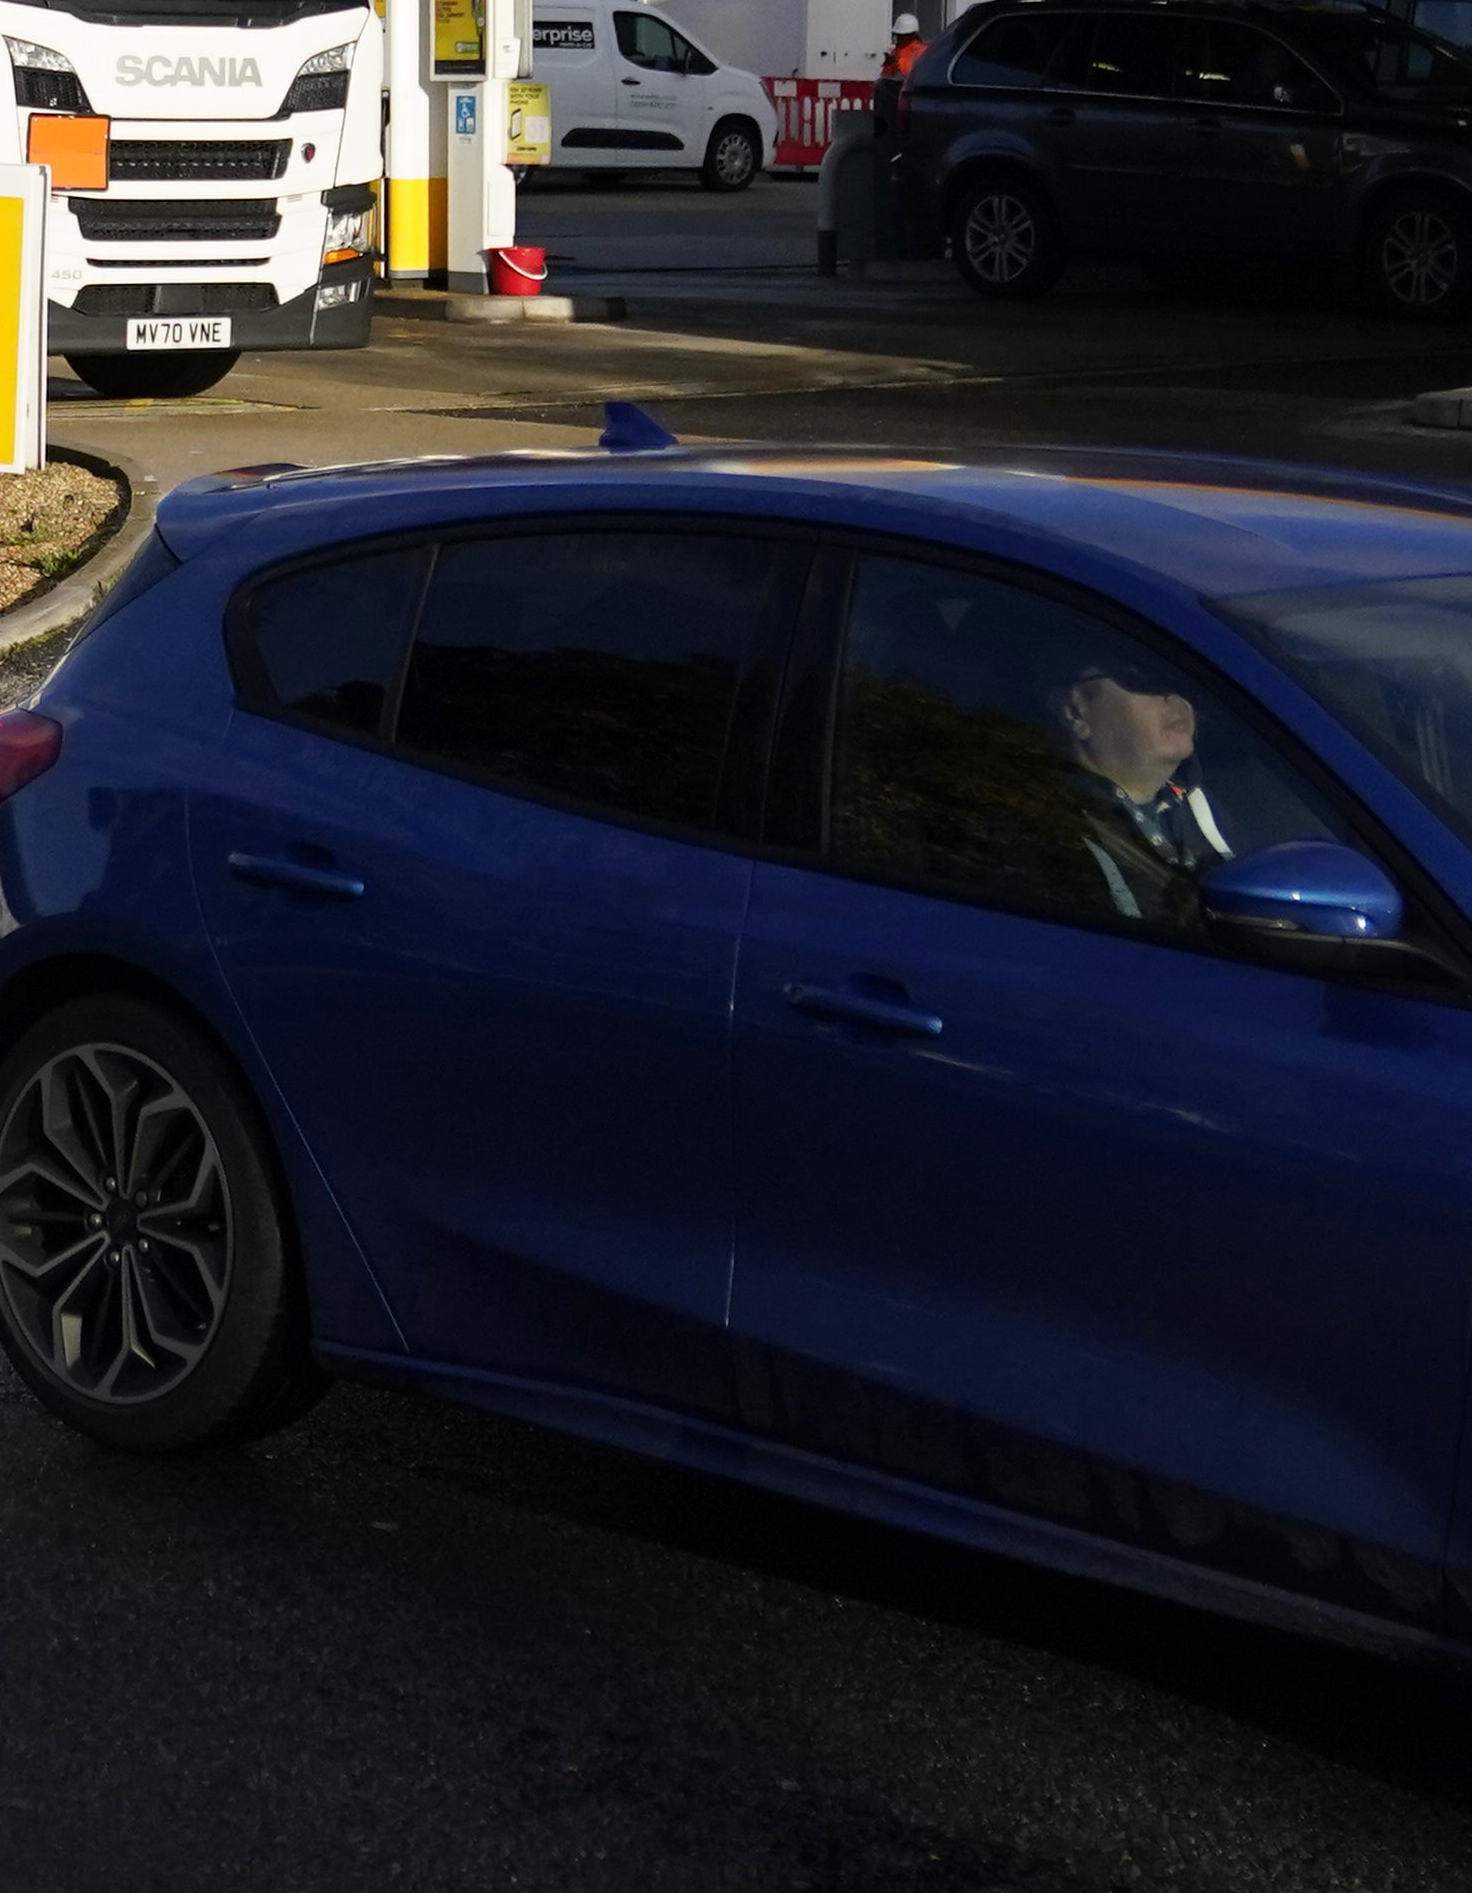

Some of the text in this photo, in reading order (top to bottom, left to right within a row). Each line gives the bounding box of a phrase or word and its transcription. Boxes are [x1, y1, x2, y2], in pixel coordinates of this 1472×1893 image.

[115, 54, 263, 88] SCANIA
[51, 269, 83, 281] 450
[135, 322, 222, 345] MV70 VNE
